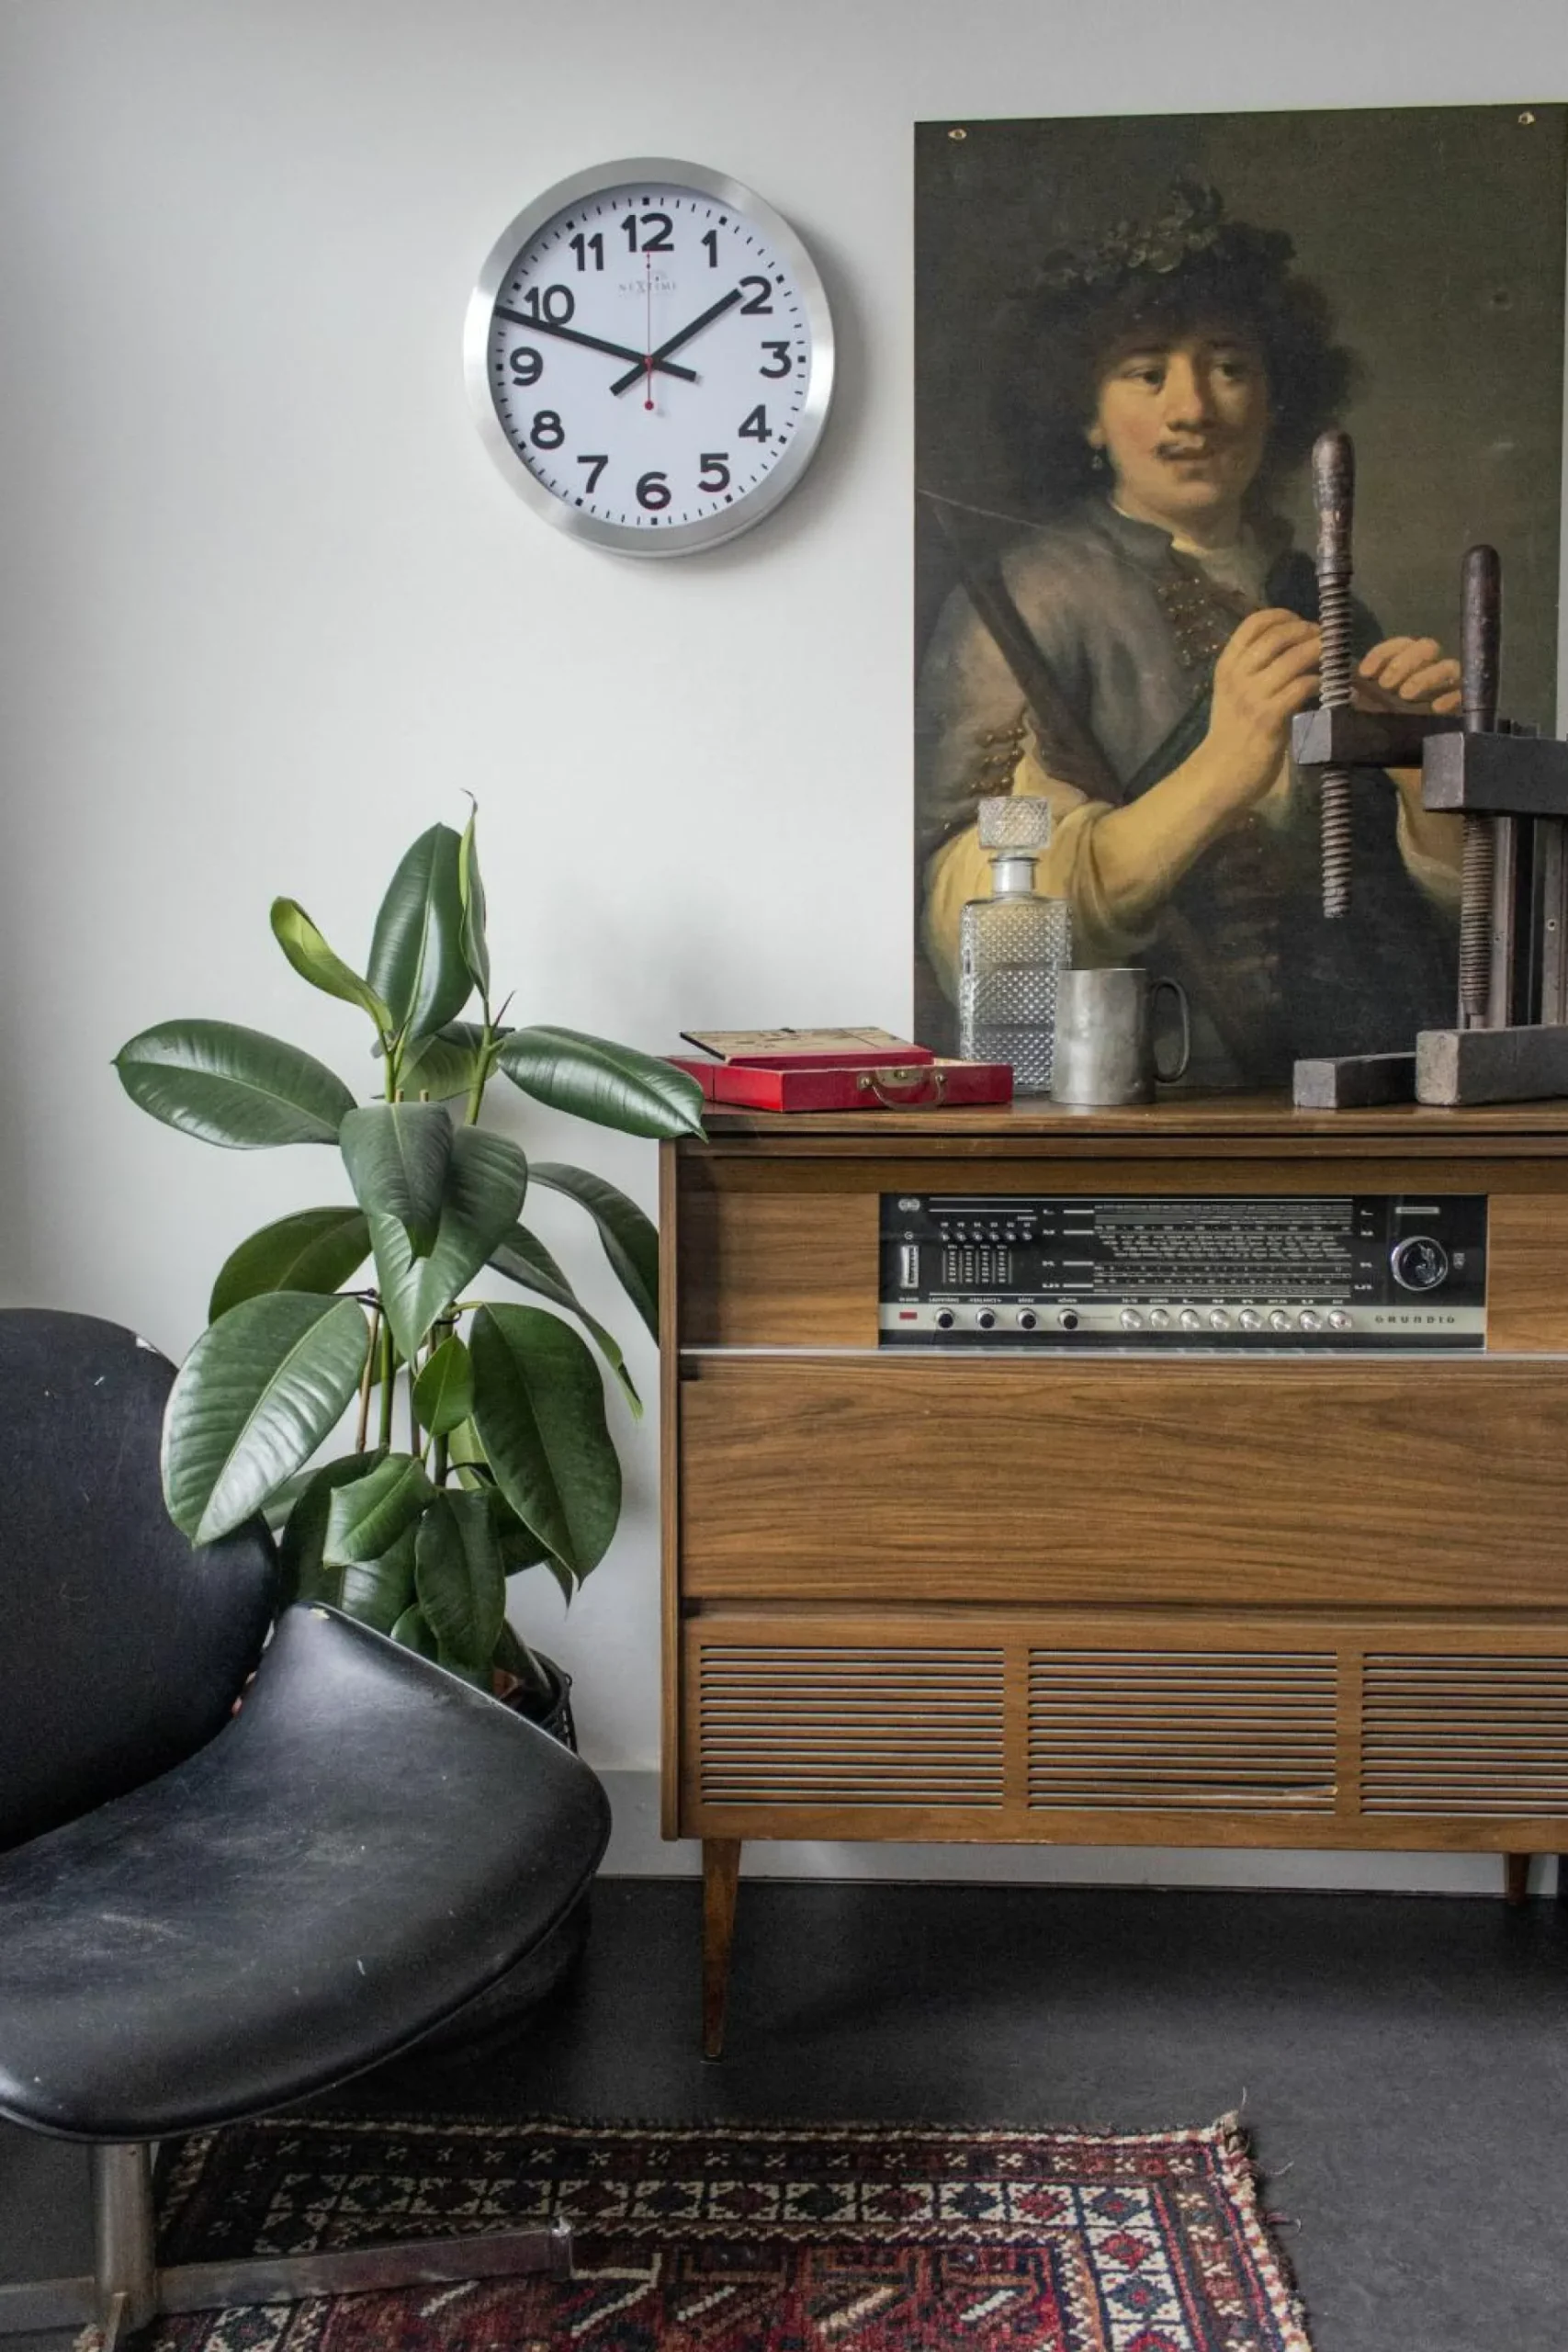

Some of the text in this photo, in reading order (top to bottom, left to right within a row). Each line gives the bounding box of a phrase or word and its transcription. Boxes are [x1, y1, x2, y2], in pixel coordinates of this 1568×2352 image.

[569, 232, 604, 272] 11
[621, 212, 675, 253] 12
[701, 230, 717, 268] 1
[524, 284, 575, 325] 10
[739, 276, 773, 315] 2
[509, 346, 544, 387] 9
[760, 341, 792, 379] 3
[530, 410, 565, 450] 8
[739, 404, 773, 443] 4
[577, 455, 608, 494] 7
[636, 471, 671, 511] 6
[698, 452, 730, 493] 5
